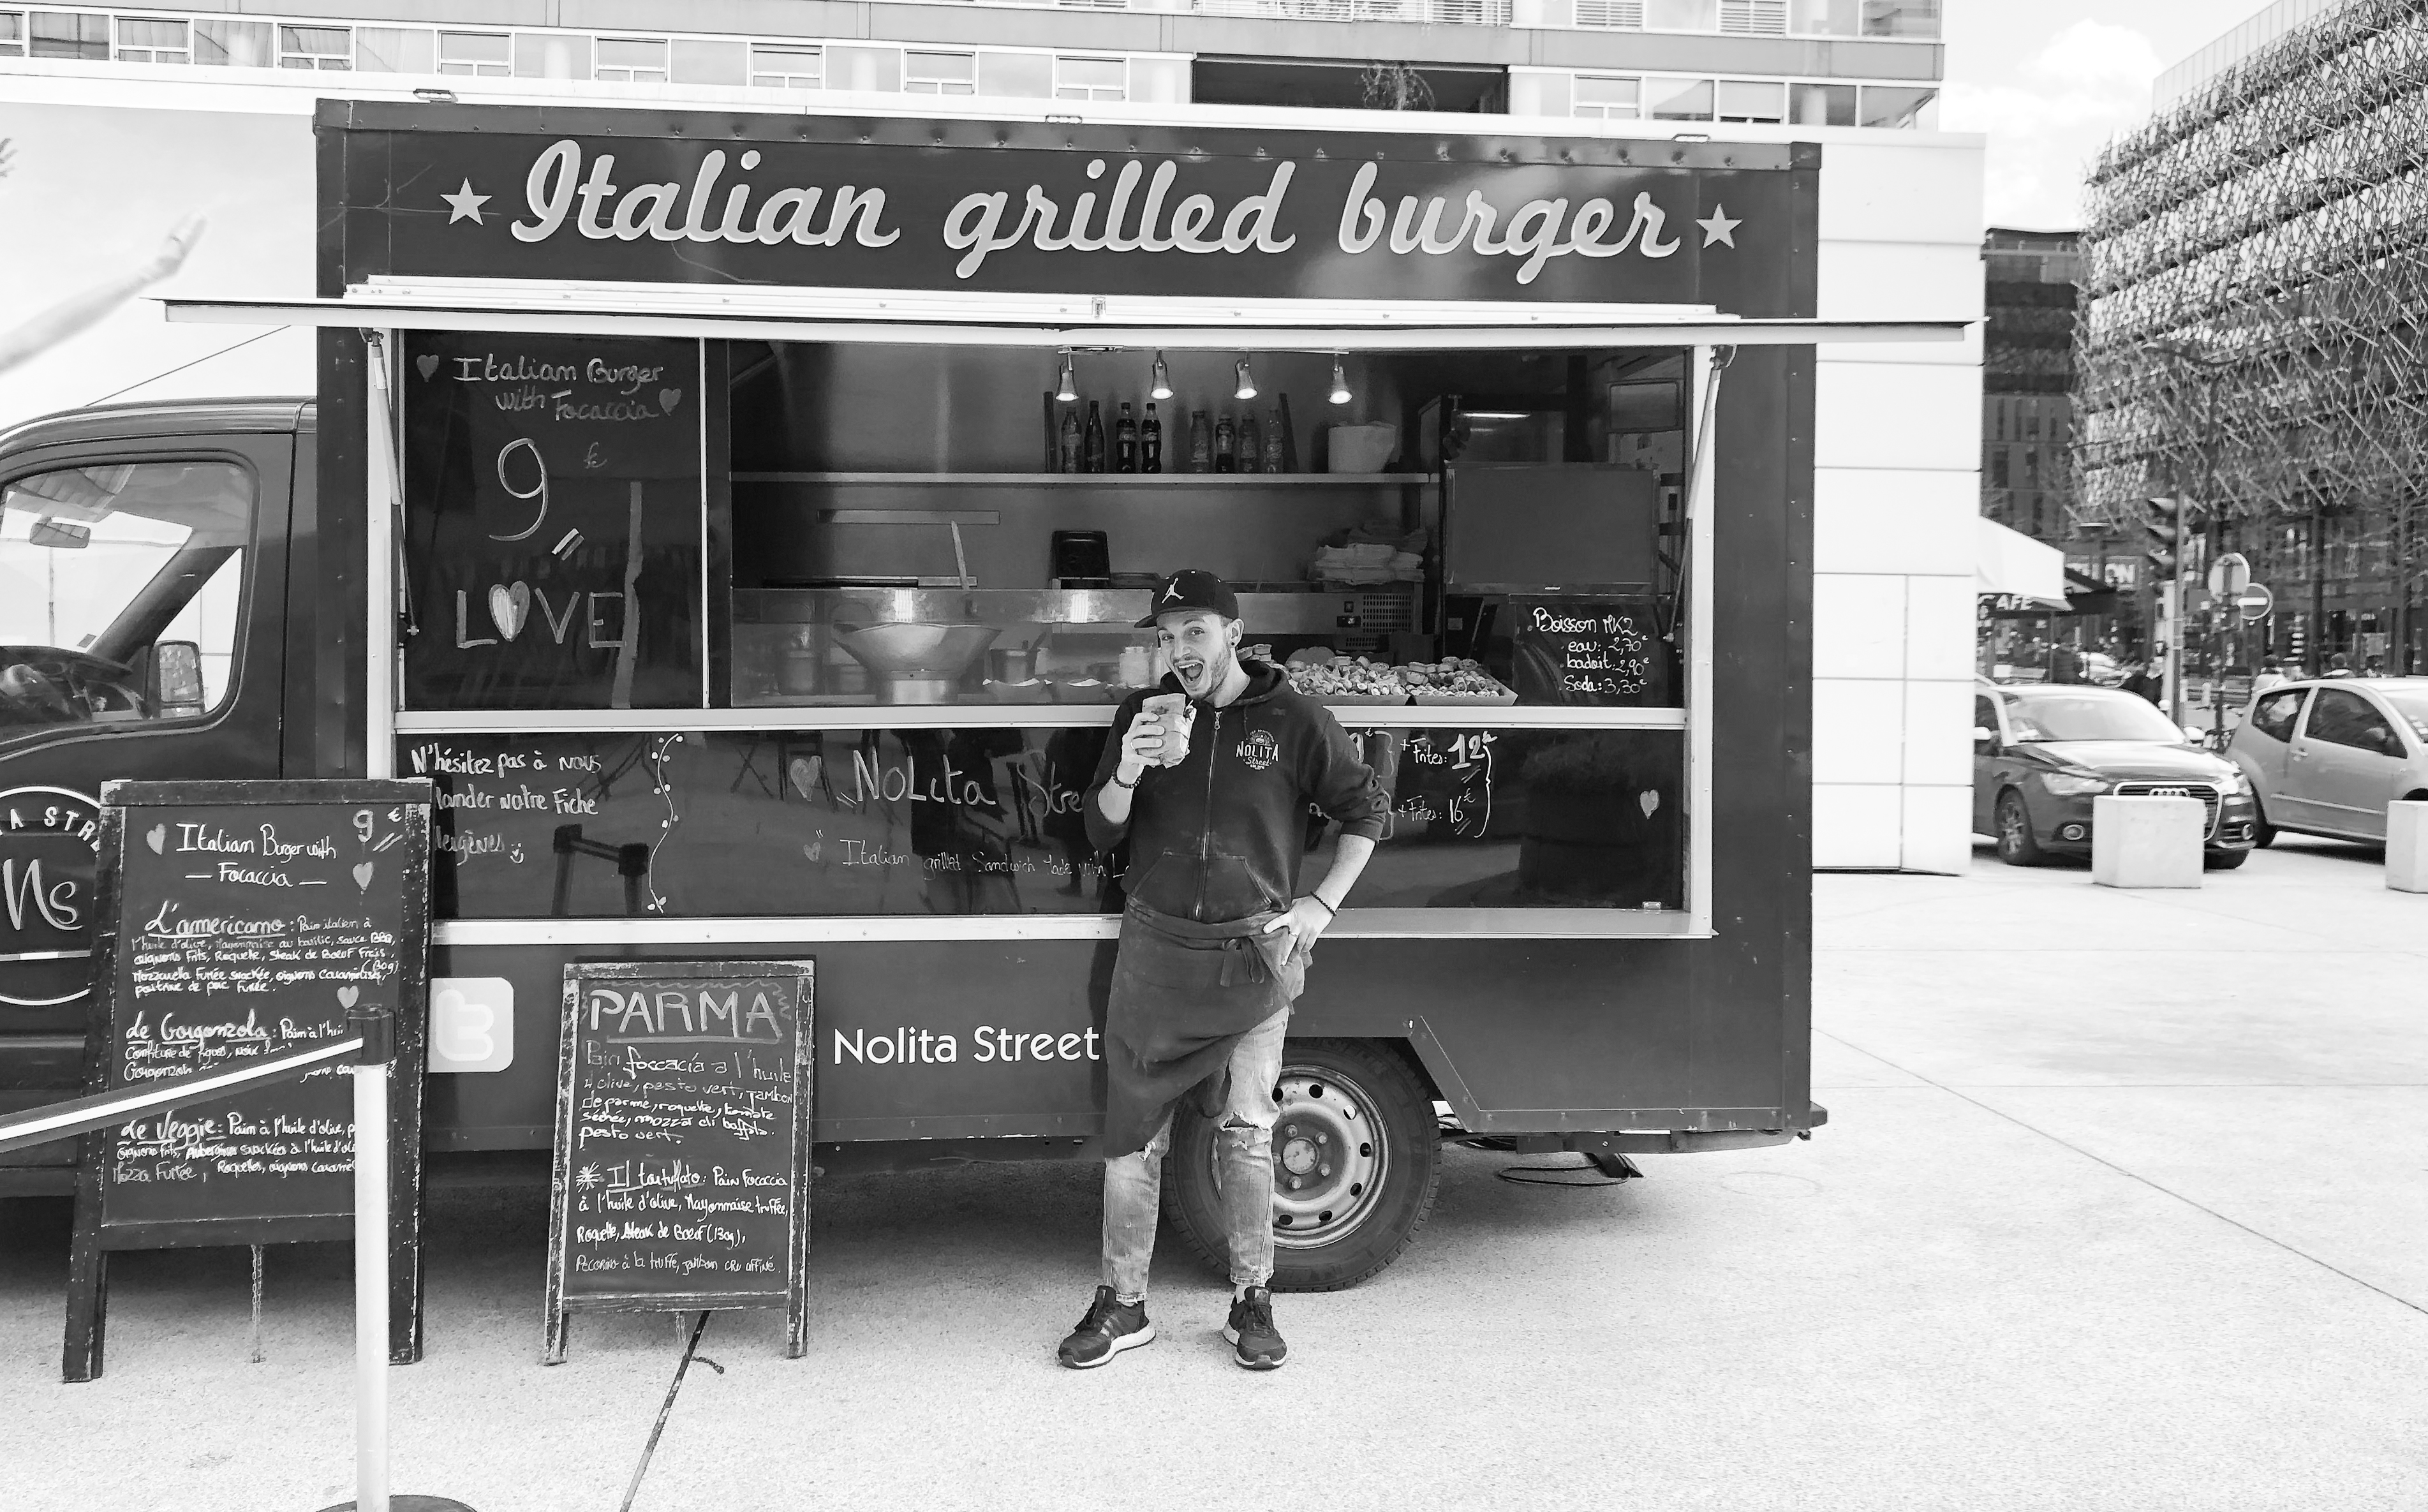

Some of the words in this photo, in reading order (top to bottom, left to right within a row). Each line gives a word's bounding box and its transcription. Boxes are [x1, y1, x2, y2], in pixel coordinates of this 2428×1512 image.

[511, 138, 900, 248] Italian
[943, 158, 1296, 279] grilled
[1337, 161, 1680, 285] burger
[452, 353, 577, 382] Italian
[489, 438, 549, 541] 9
[1533, 607, 1597, 633] Boisson
[1236, 740, 1278, 762] NOLITA
[498, 753, 526, 778] pas
[533, 750, 547, 770] à
[1016, 749, 1083, 818] Stre
[176, 822, 254, 853] Italian
[260, 824, 305, 864] Burger
[306, 835, 336, 859] with
[840, 839, 910, 866] Italian
[218, 862, 294, 888] Focaccia
[363, 917, 372, 929] à
[188, 981, 202, 992] de
[589, 989, 784, 1039] PARMA
[279, 1018, 307, 1039] Pain
[307, 1026, 318, 1038] à
[178, 1044, 191, 1059] de
[586, 1039, 621, 1067] Pain
[834, 1026, 957, 1065] Nolita
[973, 1025, 1100, 1062] Street
[642, 1078, 697, 1099] pesto
[226, 1112, 256, 1135] Pain
[258, 1120, 271, 1136] à
[274, 1115, 306, 1138] l'huile
[633, 1115, 693, 1128] mozza
[290, 1143, 302, 1154] à
[578, 1125, 629, 1150] pesto
[712, 1166, 739, 1187] Pain
[578, 1196, 589, 1212] à
[597, 1192, 634, 1213] l'huile
[638, 1190, 682, 1212] d'olive,
[656, 1220, 670, 1239] de
[622, 1254, 631, 1270] à
[633, 1250, 646, 1268] la
